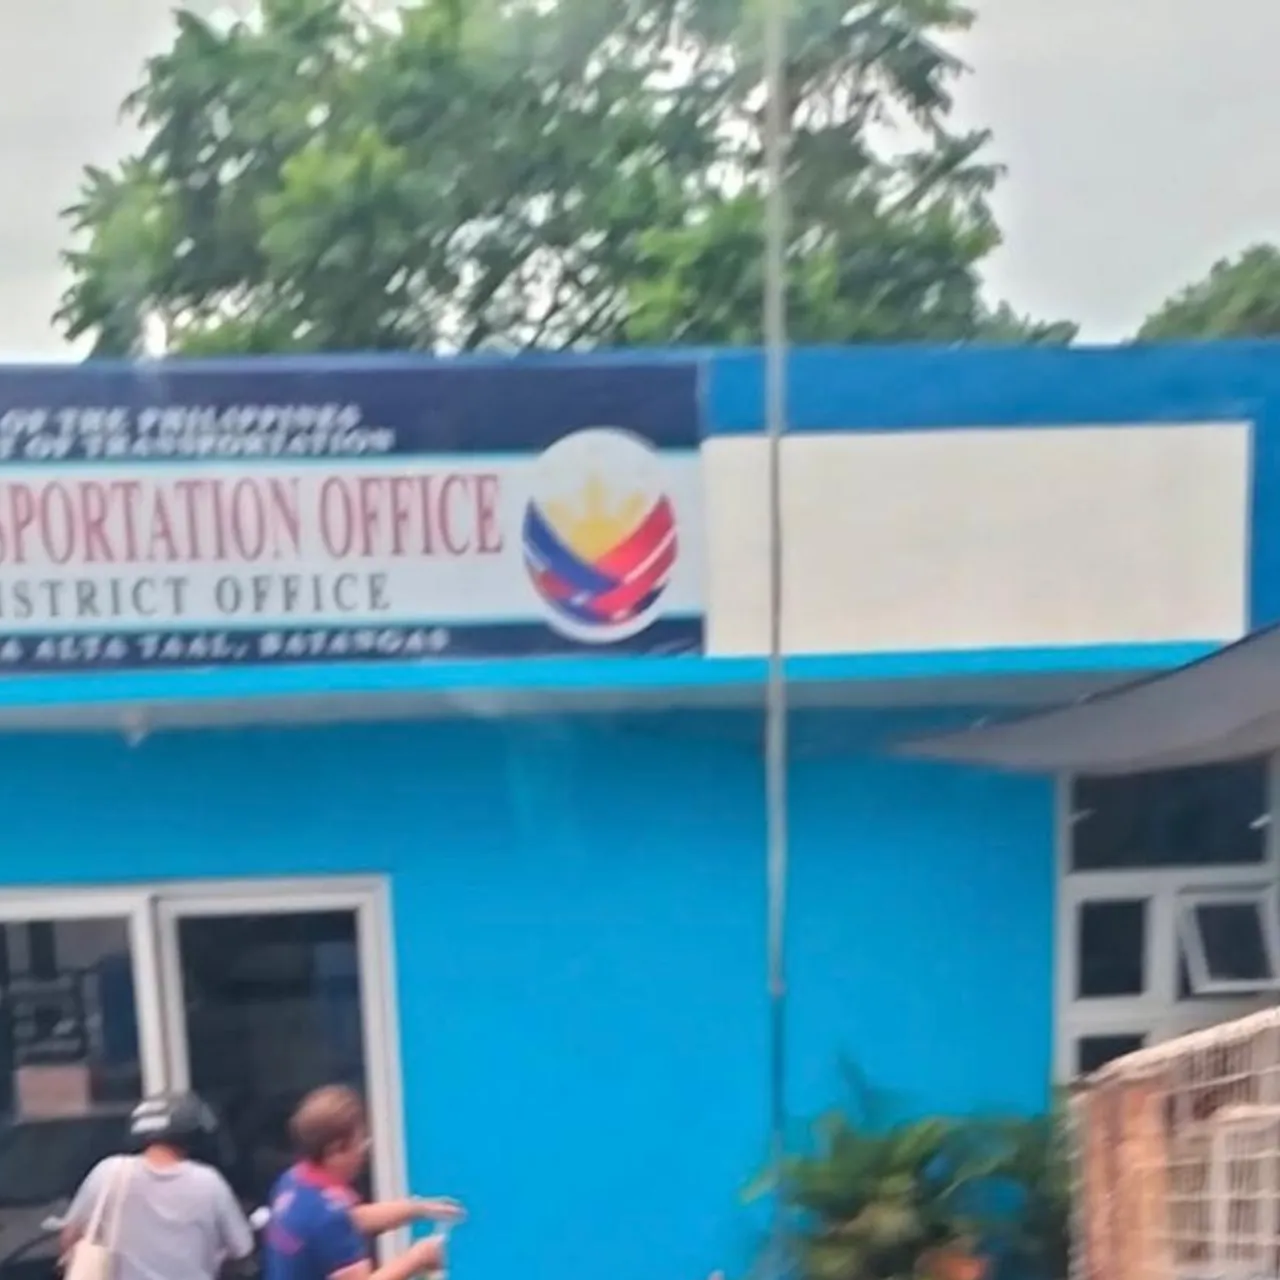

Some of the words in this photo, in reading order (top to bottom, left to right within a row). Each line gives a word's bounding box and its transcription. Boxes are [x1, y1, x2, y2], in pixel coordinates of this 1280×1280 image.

[319, 472, 506, 559] OFFICE
[214, 571, 392, 614] OFFICE
[34, 635, 129, 663] ALTA
[258, 628, 451, 657] BATANGAS
